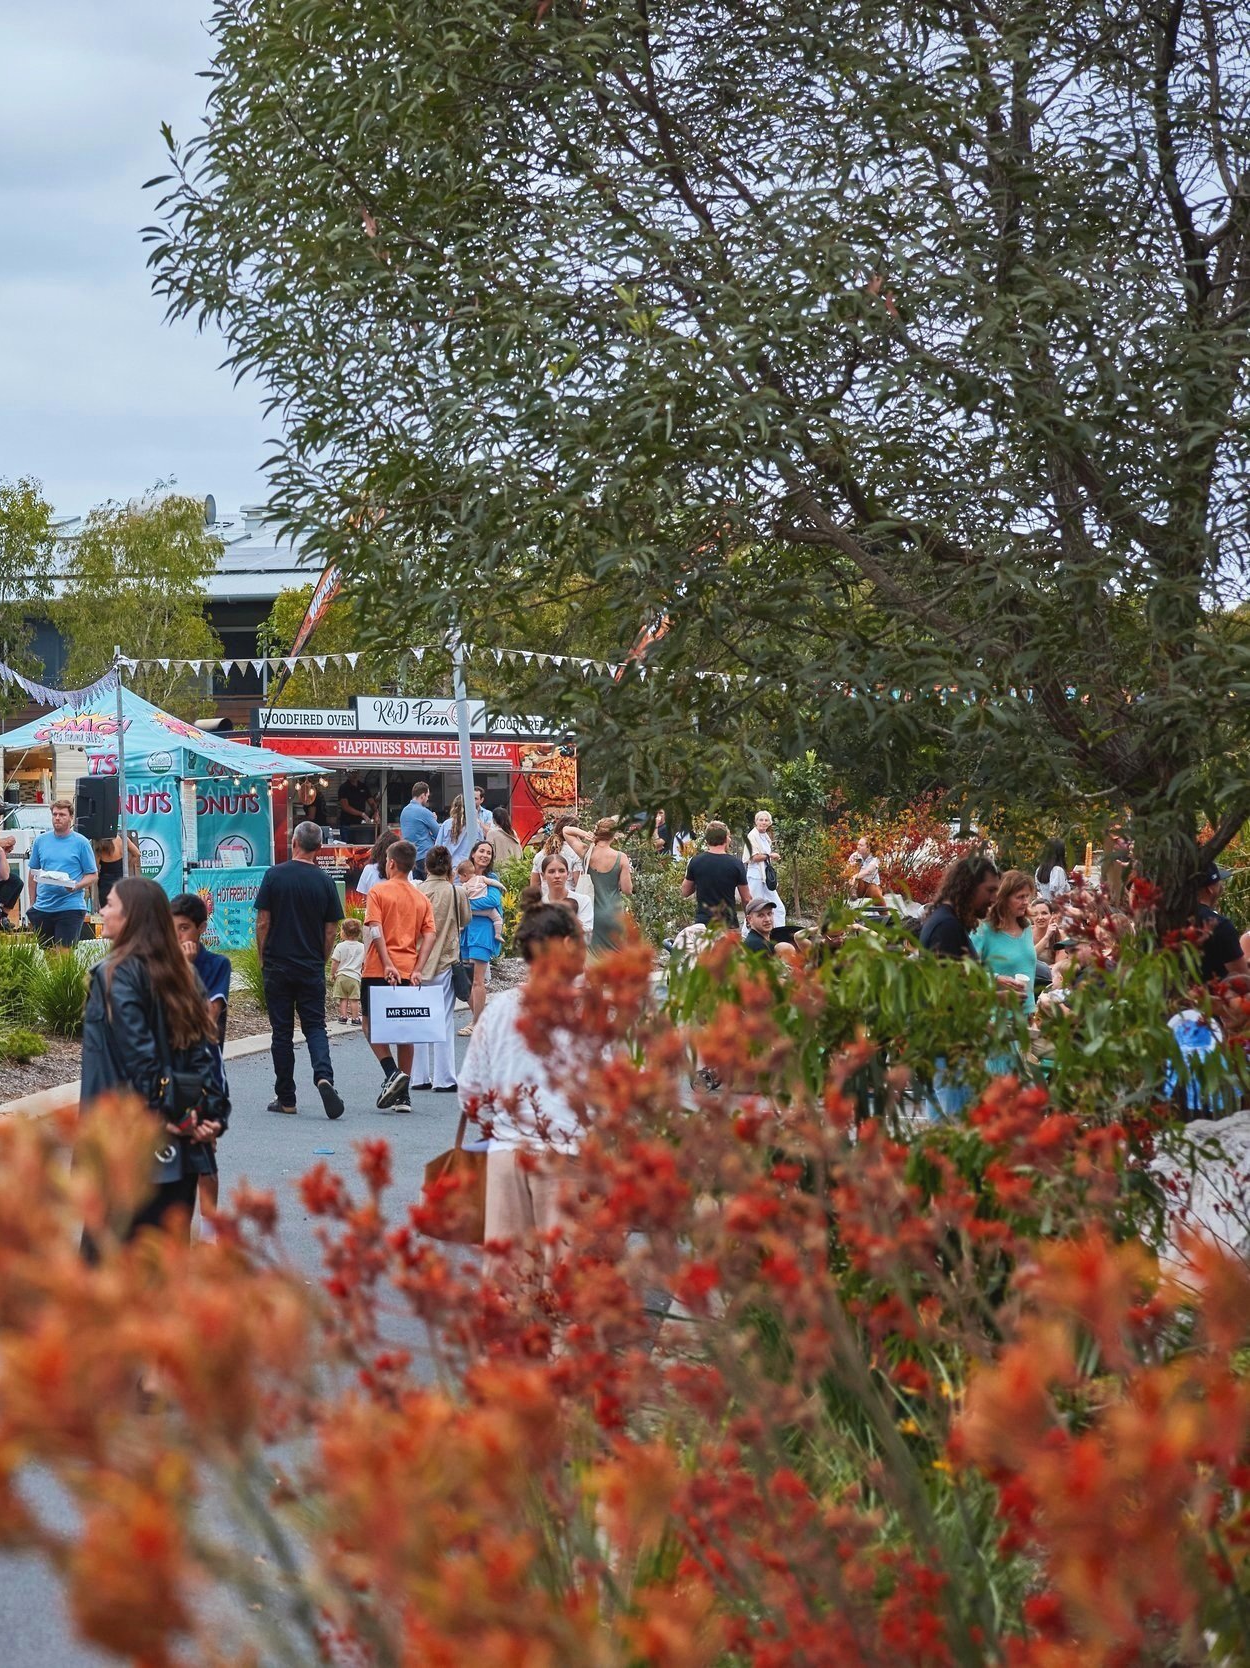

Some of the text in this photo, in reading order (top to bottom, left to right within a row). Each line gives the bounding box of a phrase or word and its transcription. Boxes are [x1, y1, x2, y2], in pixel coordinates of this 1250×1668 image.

[261, 713, 354, 726] WOODFIRED OVEN
[373, 700, 449, 726] K&D Pizza
[338, 741, 507, 758] HAPPINESS SMELLS LI PIZZA
